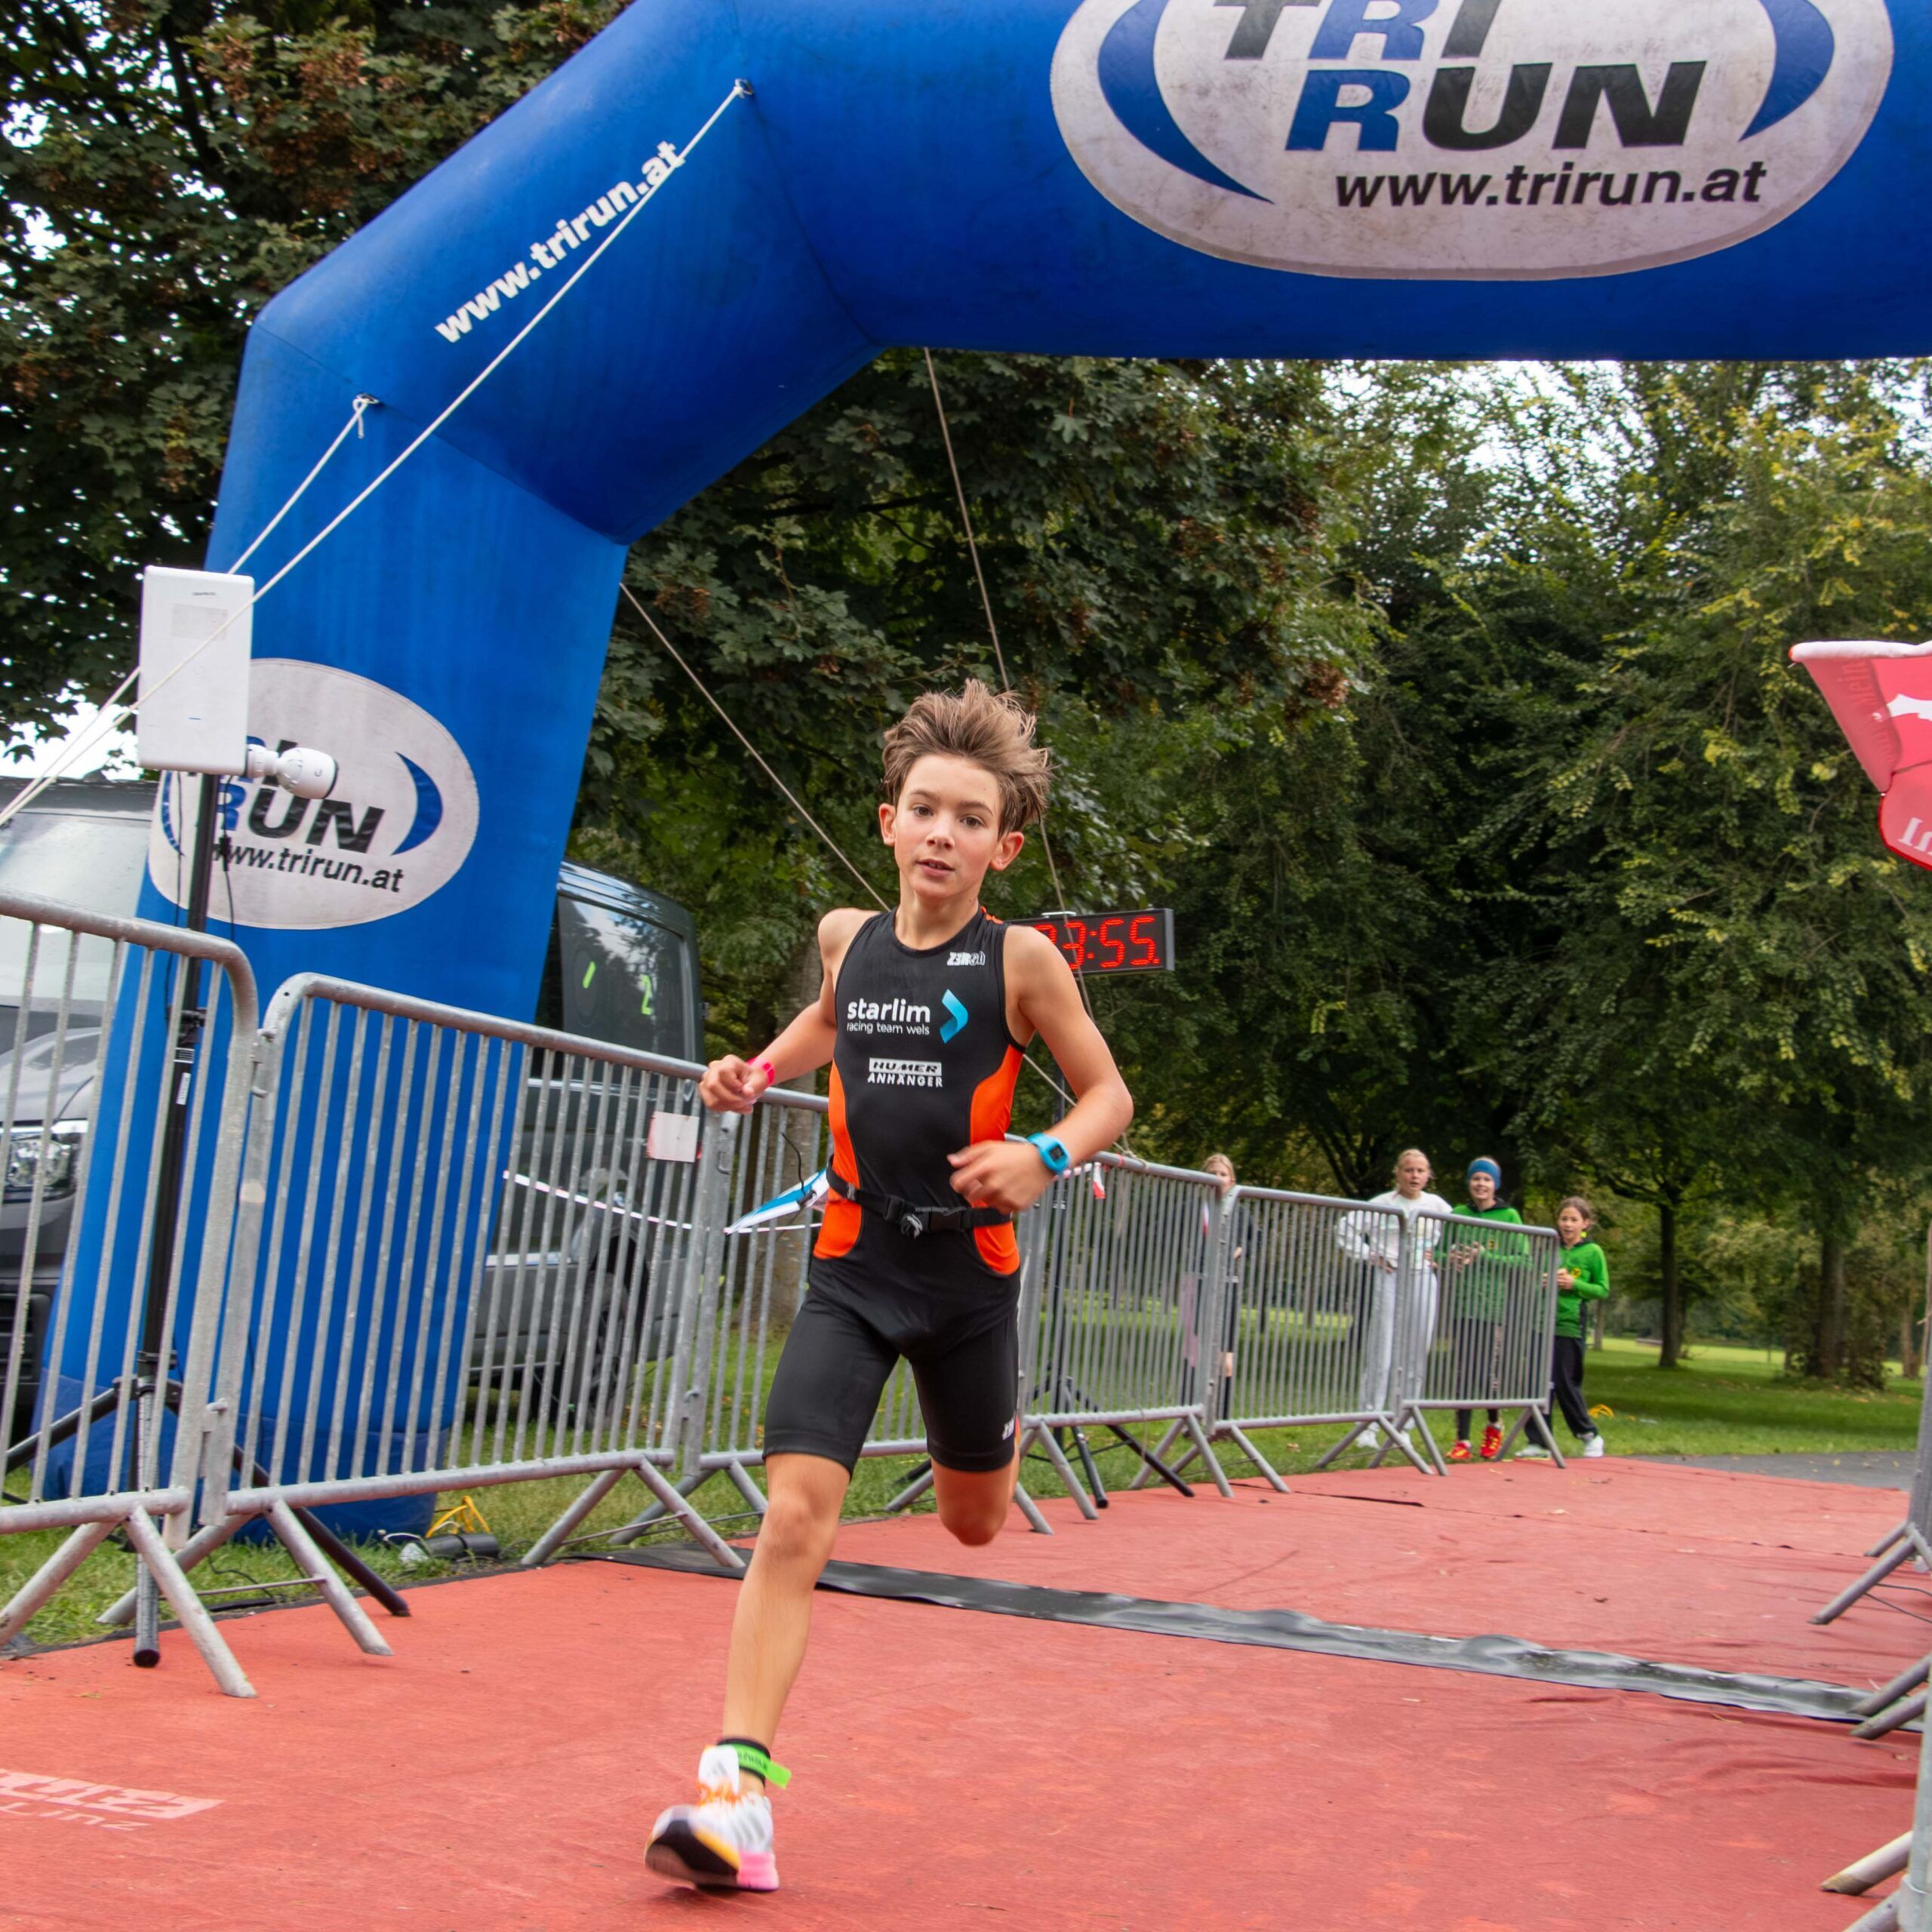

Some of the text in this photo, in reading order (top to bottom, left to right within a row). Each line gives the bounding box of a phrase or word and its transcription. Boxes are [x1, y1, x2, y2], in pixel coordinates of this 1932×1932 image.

[1214, 0, 1500, 60] TRI
[1284, 60, 1708, 152] RUN
[1335, 162, 1767, 208] www.trirun.at
[435, 141, 685, 343] www.trirun.at
[213, 843, 405, 893] ww.trirun.at
[847, 998, 931, 1023] starlim
[847, 1020, 930, 1035] racing team wels
[867, 1071, 943, 1088] ANHÄNGER
[873, 1061, 938, 1073] HUMER
